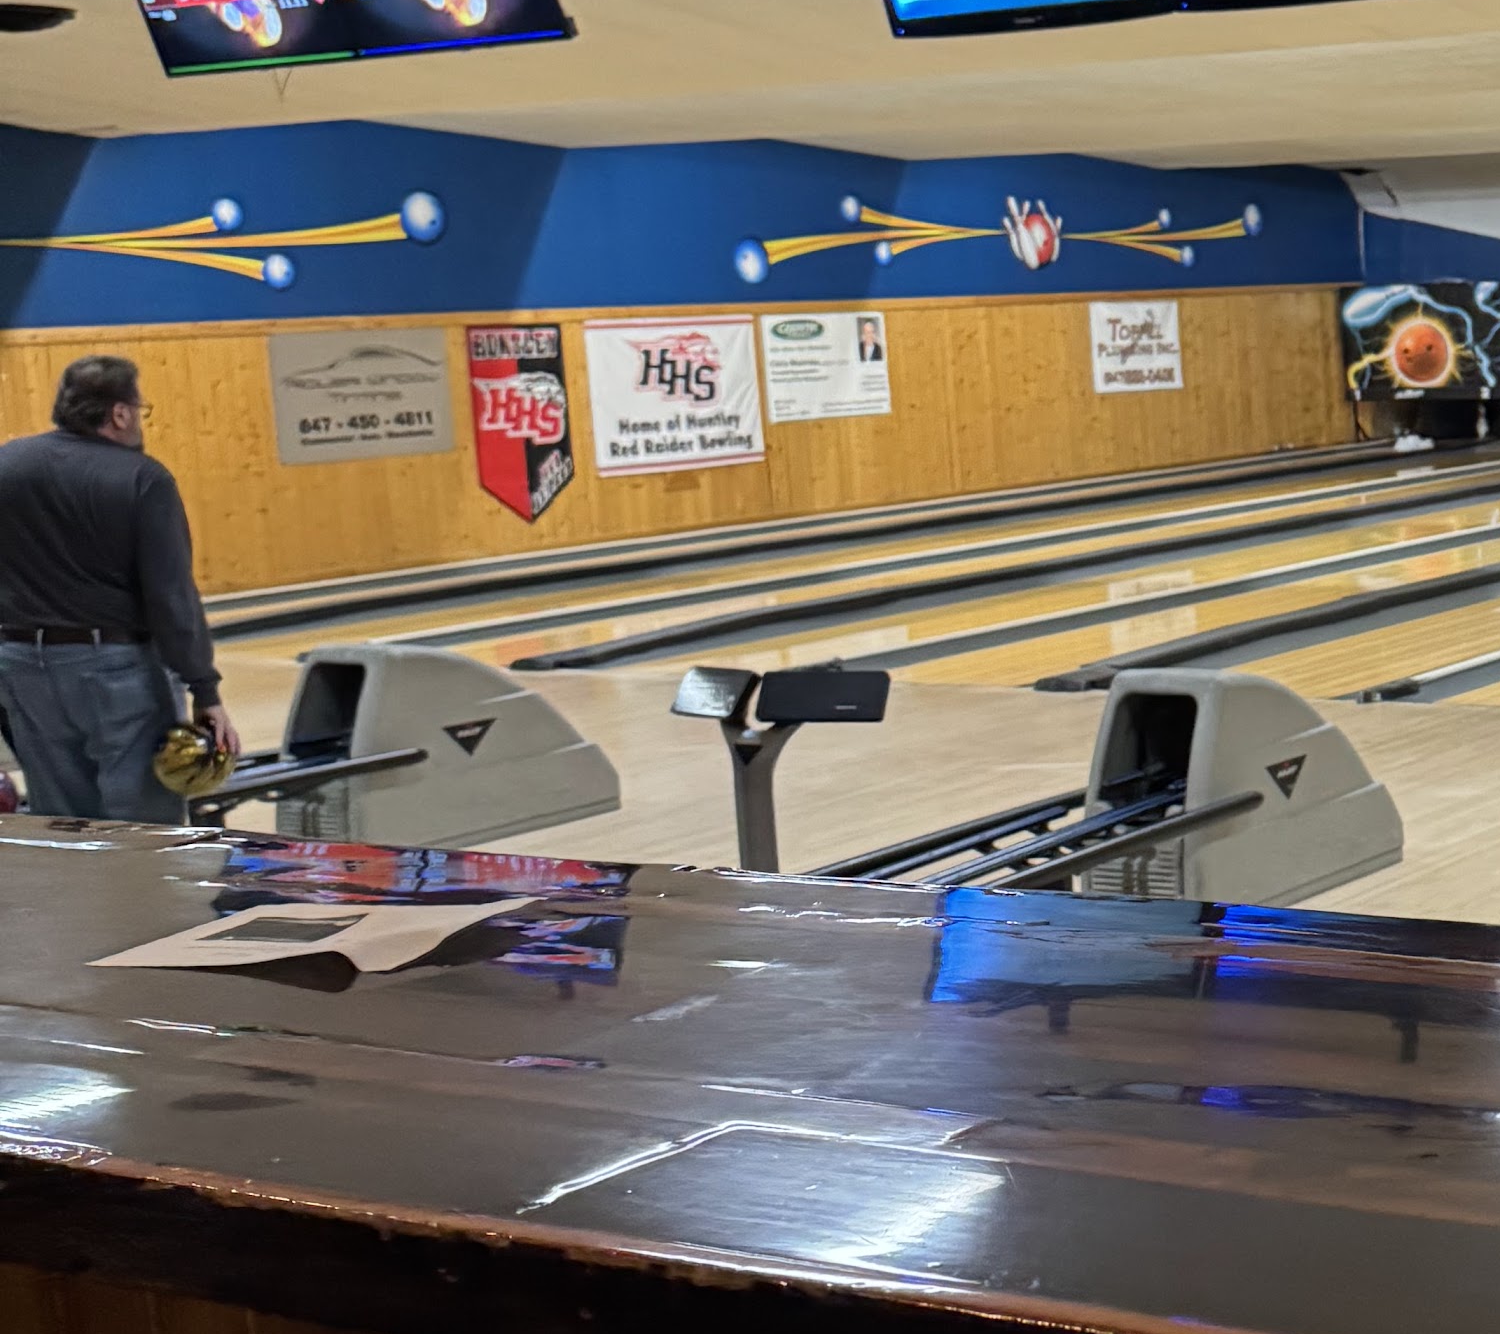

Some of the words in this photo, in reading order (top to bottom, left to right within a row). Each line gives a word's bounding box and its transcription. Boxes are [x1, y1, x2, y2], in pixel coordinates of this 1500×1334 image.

[639, 348, 716, 402] HHS
[480, 387, 565, 445] HHS
[618, 418, 661, 434] Home
[667, 415, 680, 430] of
[686, 412, 741, 431] Huntley
[610, 440, 639, 457] Red
[644, 436, 694, 453] Raider
[700, 432, 753, 450] Bowling
